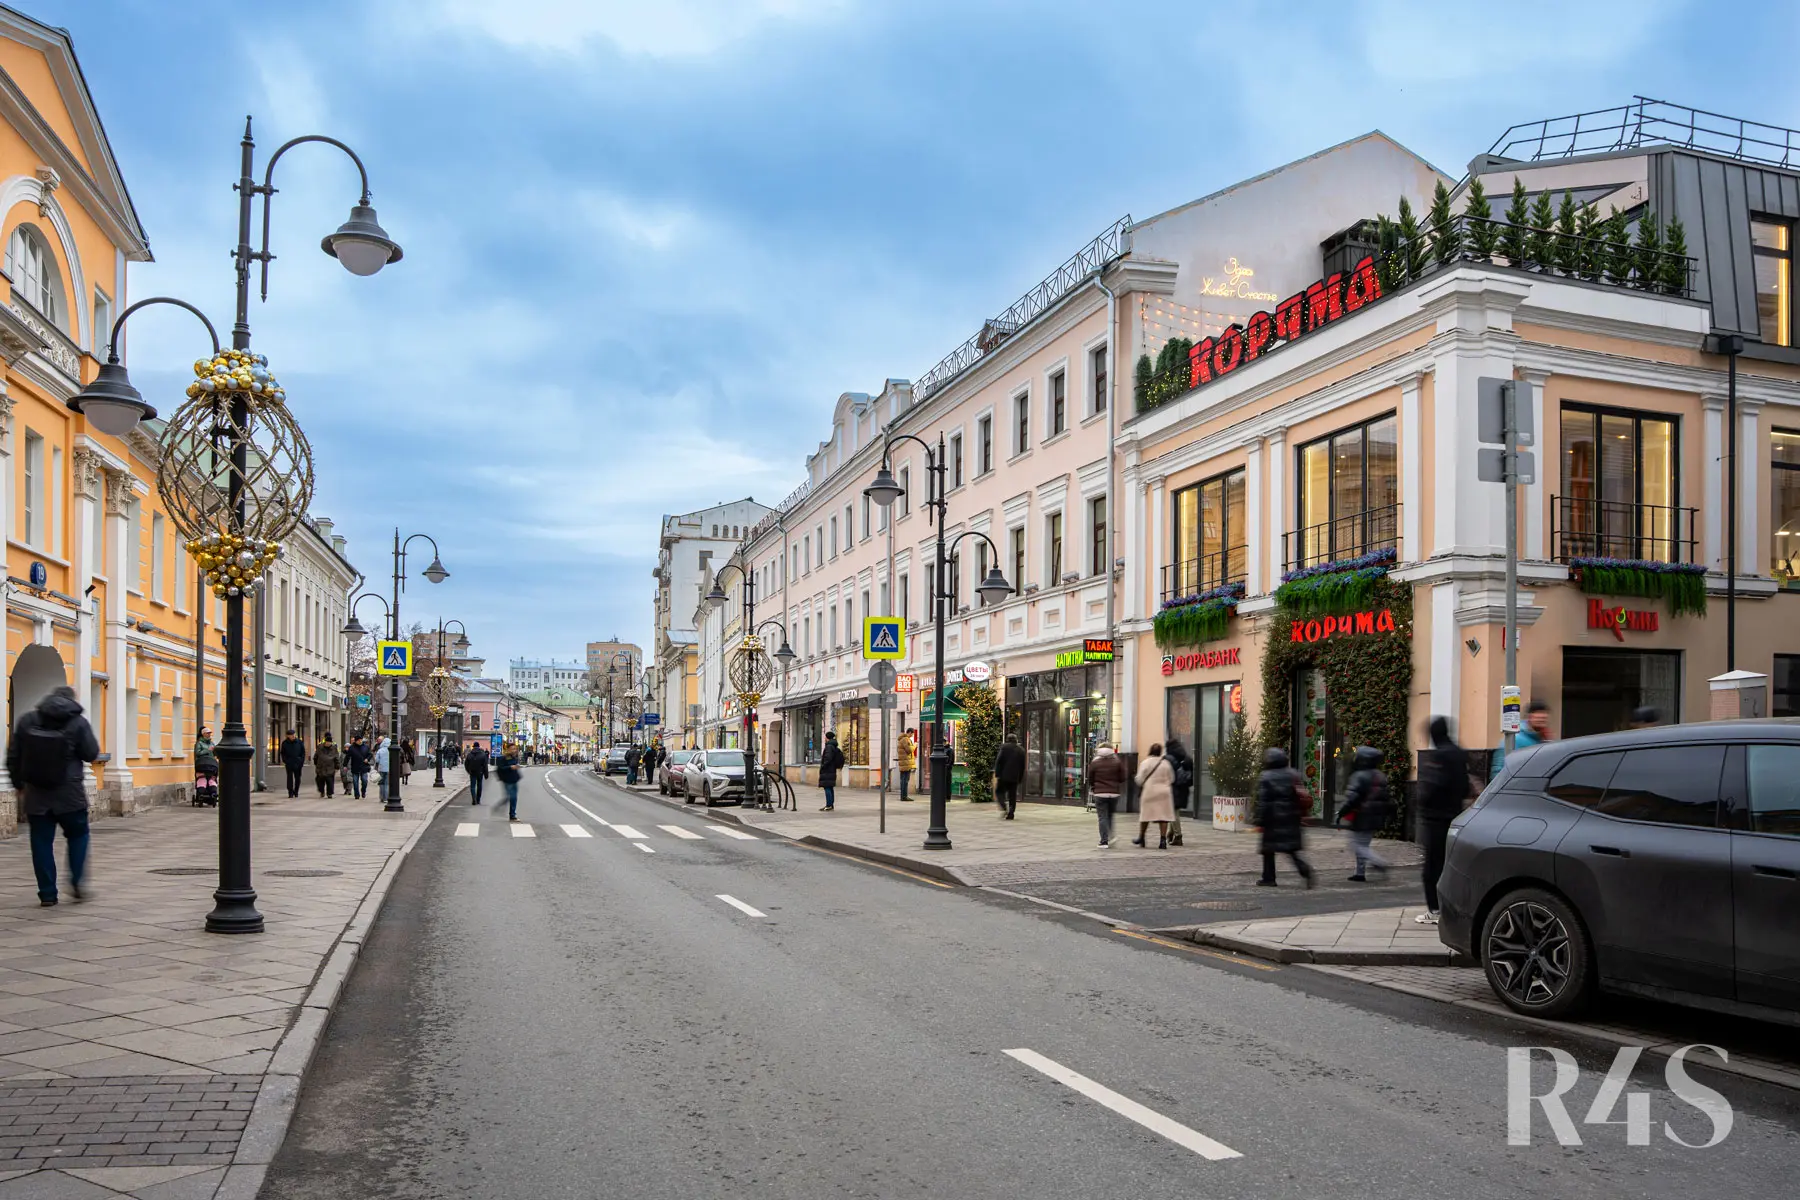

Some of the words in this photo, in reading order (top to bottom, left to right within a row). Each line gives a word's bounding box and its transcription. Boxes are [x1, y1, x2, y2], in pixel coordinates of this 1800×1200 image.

[37, 565, 45, 580] 19
[1085, 640, 1112, 651] ТАБАК
[1085, 652, 1113, 661] НАПИТКИ
[1175, 647, 1241, 671] ФОРАБАНК
[1070, 710, 1079, 723] 24
